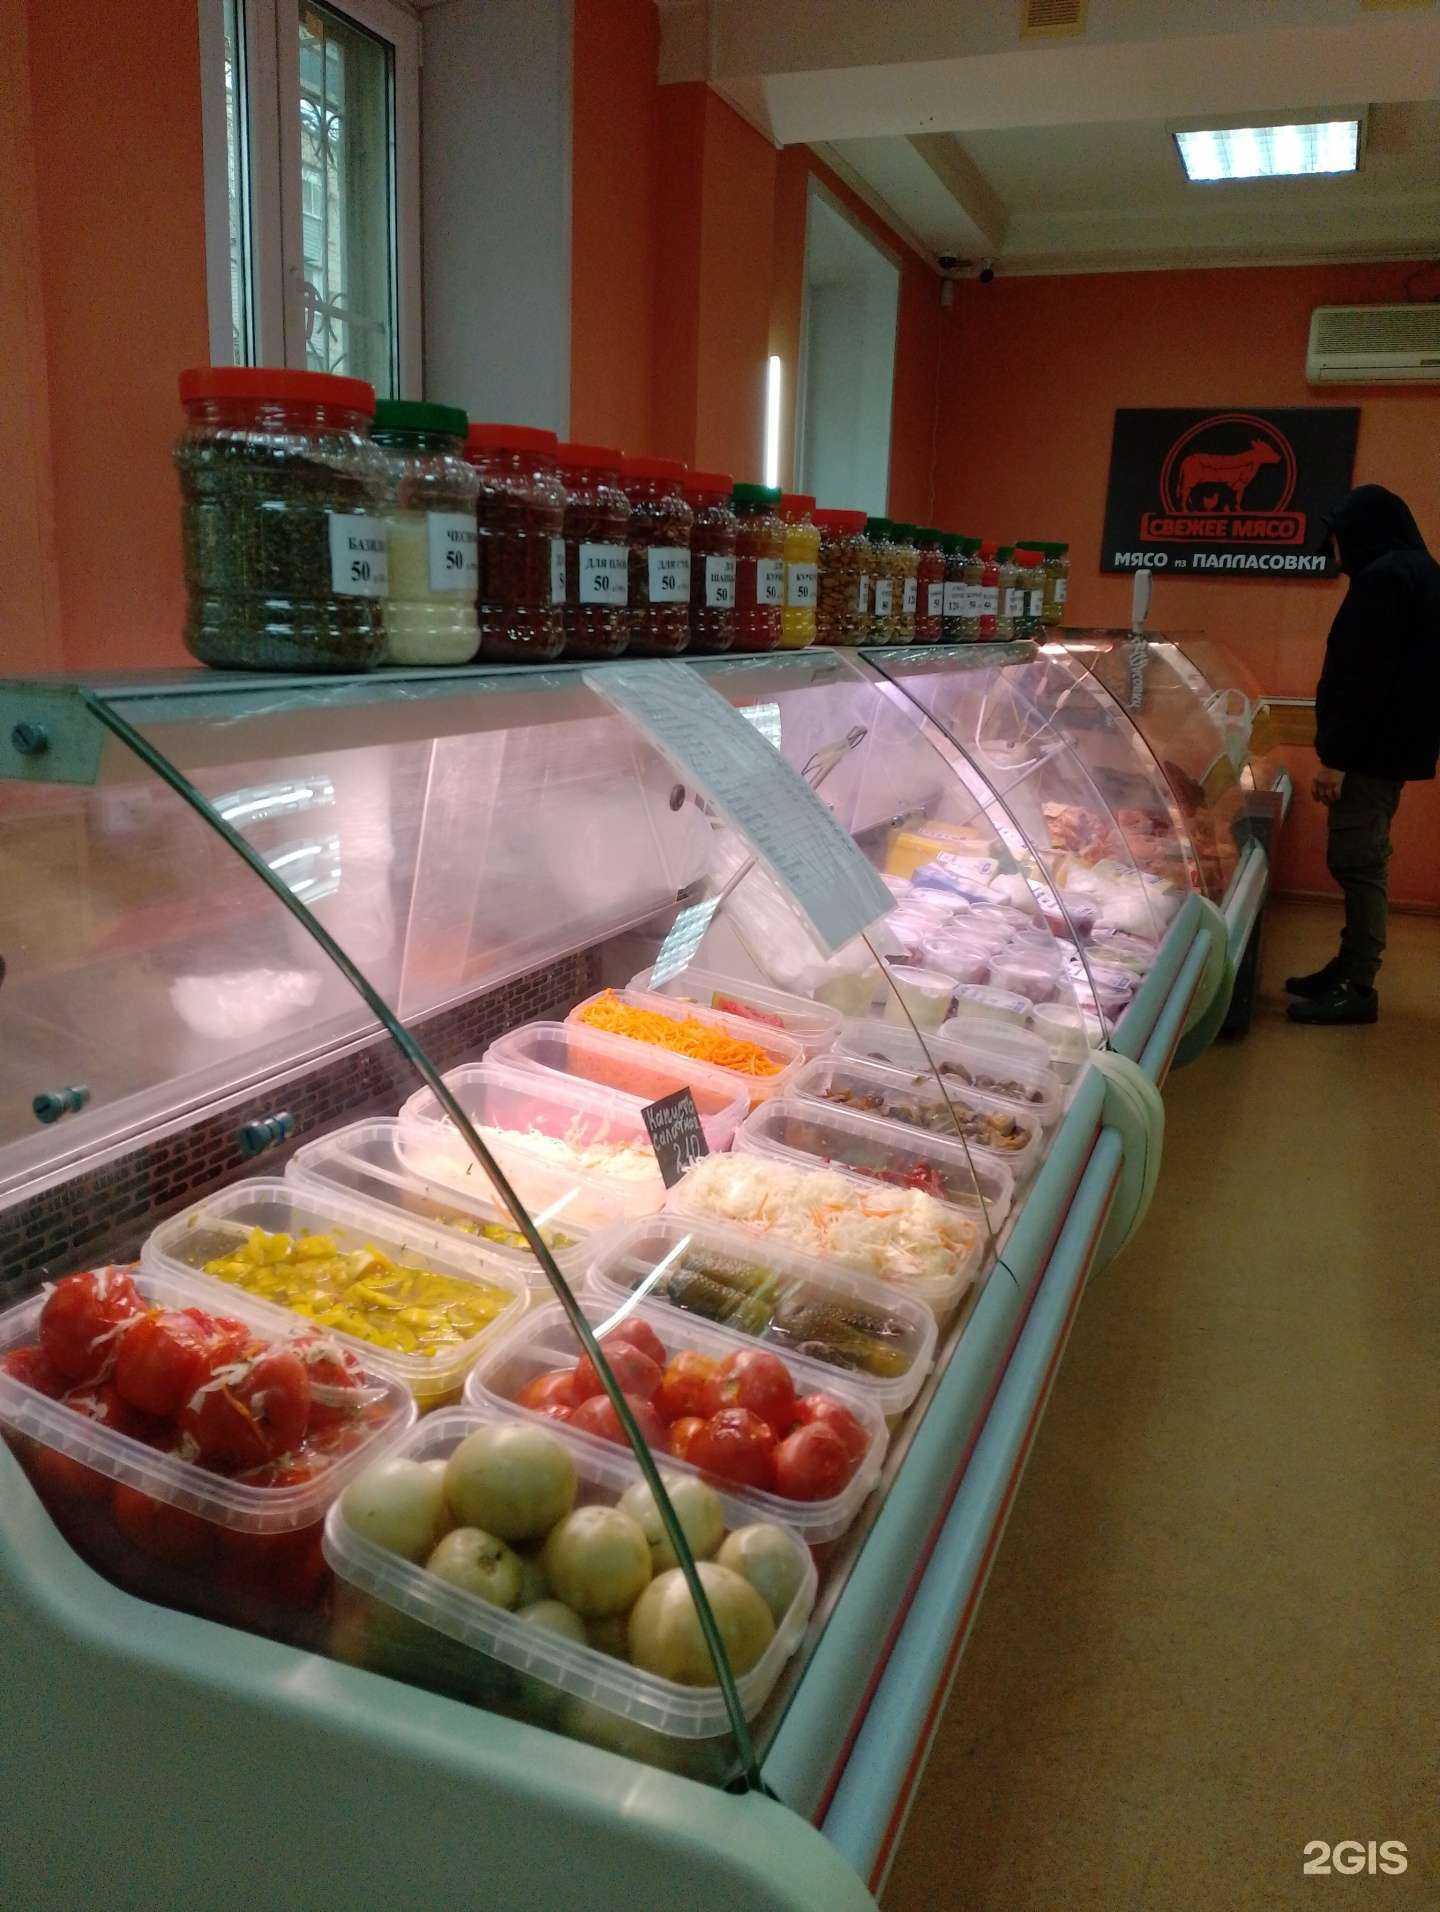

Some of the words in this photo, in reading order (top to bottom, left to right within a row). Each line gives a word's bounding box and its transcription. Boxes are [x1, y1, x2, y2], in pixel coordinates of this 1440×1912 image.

[1149, 519, 1227, 537] СВЕЖЕЕ
[1232, 519, 1295, 538] МЯСО
[446, 551, 463, 570] 50
[1114, 552, 1168, 567] МЯСО
[1192, 553, 1326, 570] ПАЛЛАСОВКИ
[351, 560, 370, 582] 50
[593, 575, 609, 591] 50
[661, 575, 675, 590] 50
[716, 588, 728, 601] 50
[766, 586, 777, 599] 50
[797, 586, 808, 598] 50
